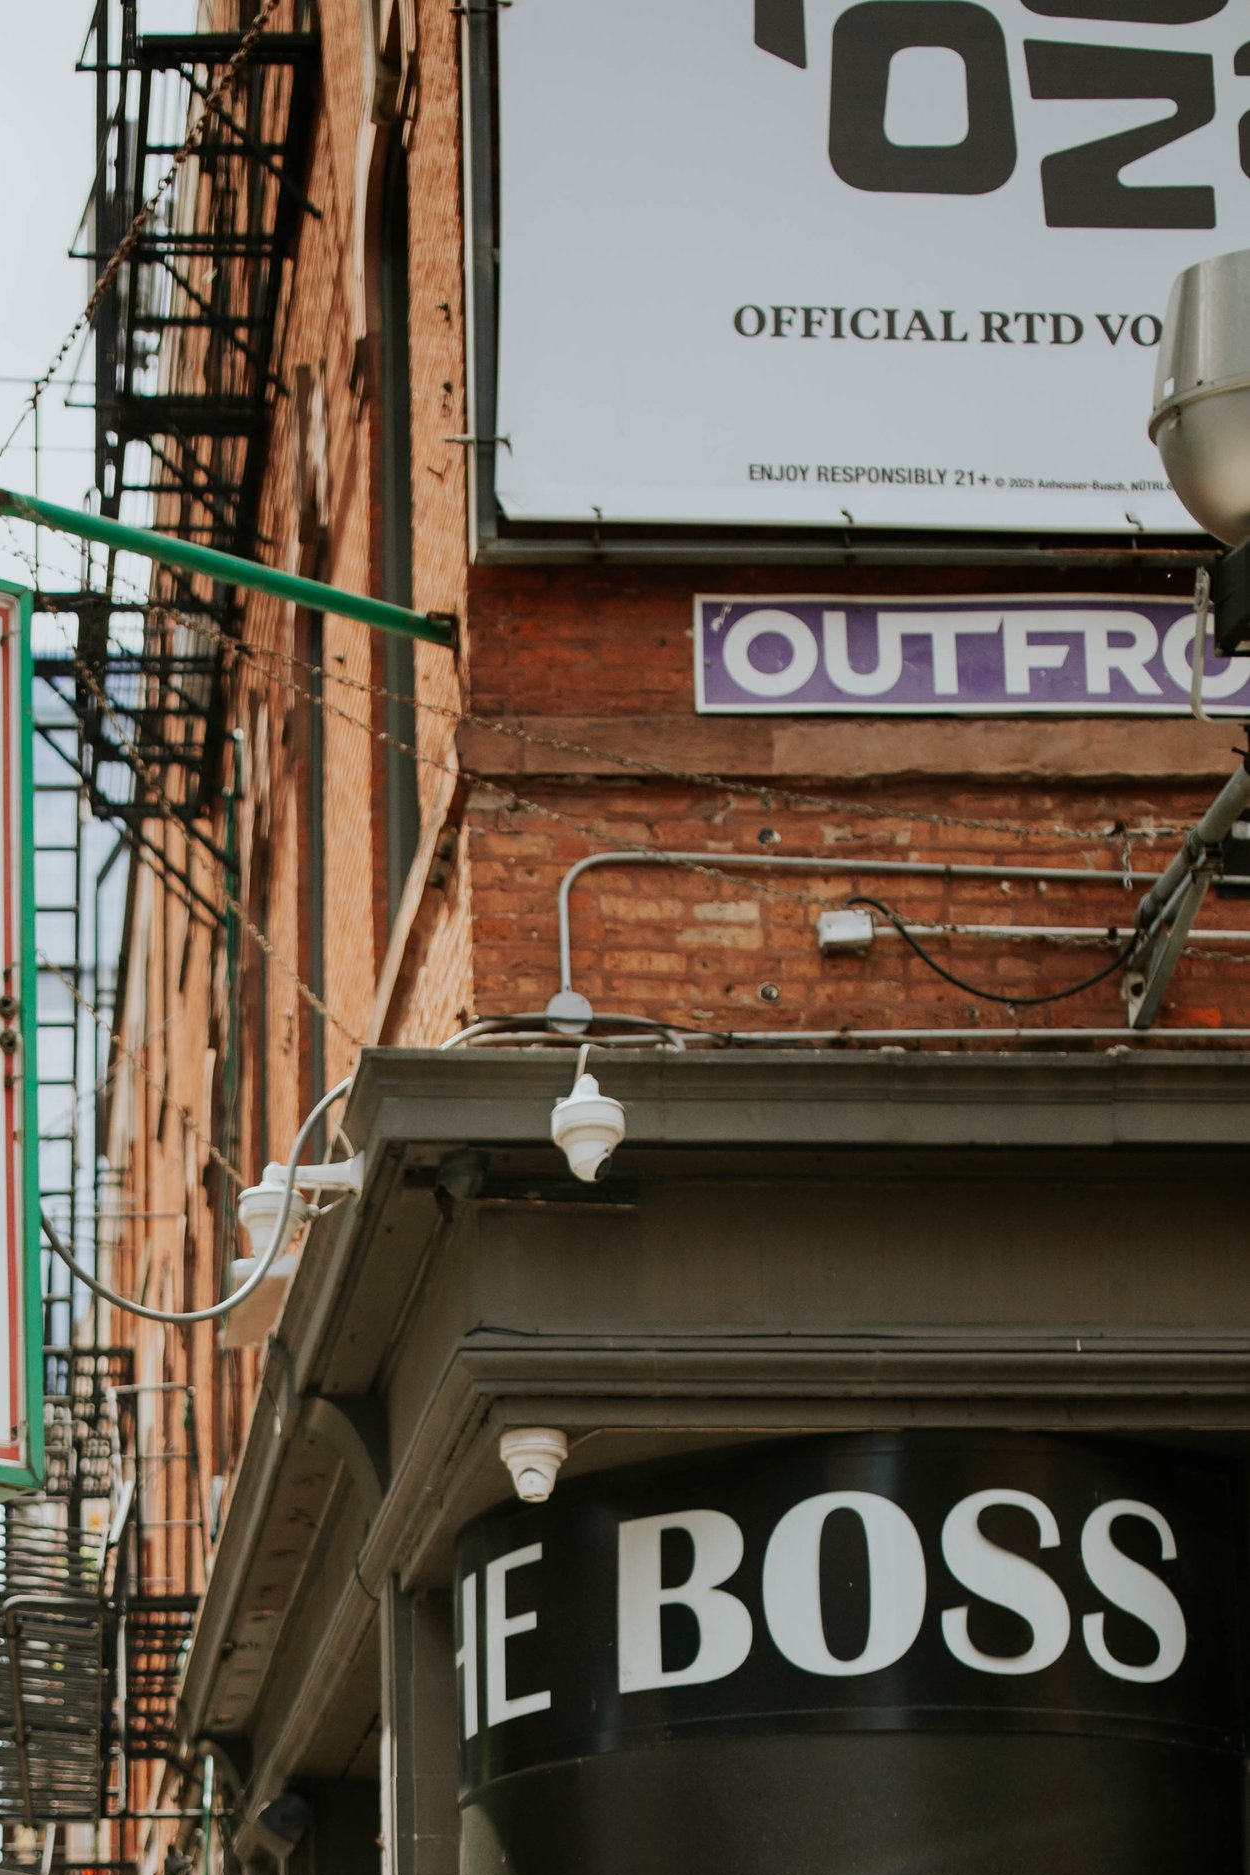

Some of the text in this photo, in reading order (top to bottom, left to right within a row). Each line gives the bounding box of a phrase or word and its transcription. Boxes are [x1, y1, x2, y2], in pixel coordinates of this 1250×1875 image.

[733, 304, 969, 342] OFFICIAL
[980, 311, 1084, 345] RTD
[748, 464, 810, 482] ENJOY
[817, 465, 948, 485] RESPONSIBLY
[955, 469, 990, 486] 21+
[722, 609, 1250, 699] OUTFRO
[618, 1488, 1187, 1694] BOSS
